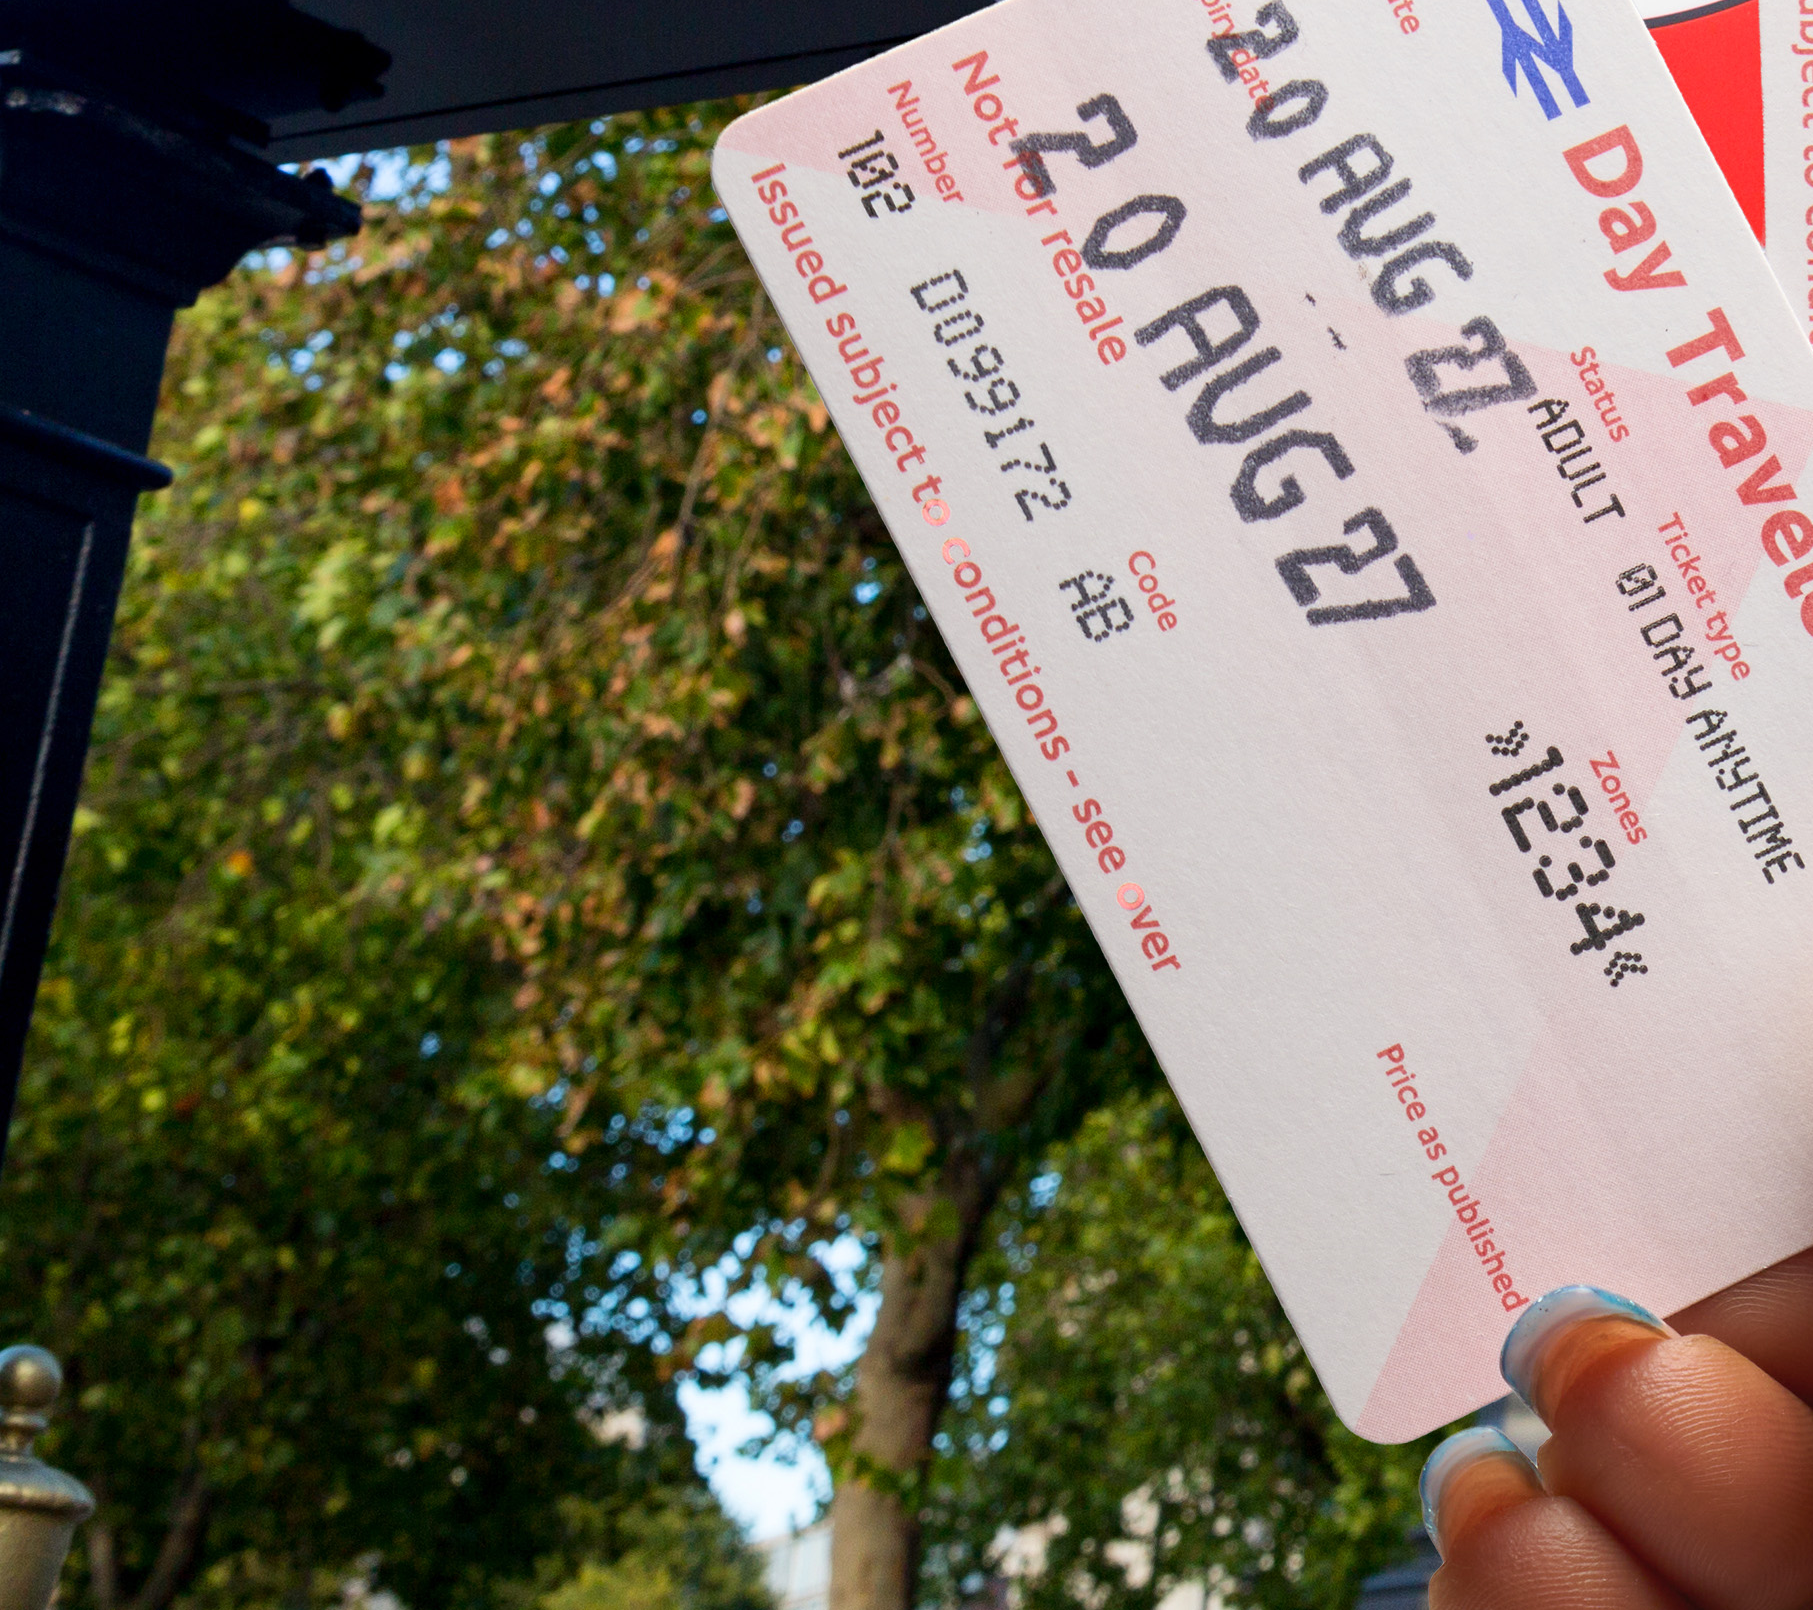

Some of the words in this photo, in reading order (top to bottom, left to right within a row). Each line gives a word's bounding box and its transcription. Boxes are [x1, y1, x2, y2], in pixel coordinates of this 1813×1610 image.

[1230, 47, 1278, 112] date
[888, 81, 966, 203] Number
[952, 51, 1020, 148] Not
[1001, 148, 1058, 218] for
[1042, 230, 1128, 367] resale
[1563, 124, 1689, 294] Day
[839, 131, 916, 219] 102
[911, 270, 1073, 523] D099172
[1299, 134, 1472, 315] AUG
[1405, 317, 1535, 425] 27
[1135, 286, 1356, 523] AUG
[1276, 508, 1438, 627] 27
[1571, 347, 1631, 444] Status
[1528, 400, 1627, 525] ADULT
[752, 163, 849, 306] Issued
[826, 312, 928, 474] subject
[912, 475, 952, 528] to
[942, 538, 1072, 763] conditions
[1073, 799, 1127, 875] see
[1117, 883, 1182, 972] over
[1059, 572, 1135, 643] AB
[1129, 551, 1179, 633] Code
[1617, 566, 1668, 610] 01
[1659, 512, 1717, 610] Ticket
[1706, 611, 1751, 682] type
[1641, 615, 1714, 701] DAY
[1590, 750, 1649, 846] Zones
[1686, 710, 1806, 885] ANYTIME
[1377, 1044, 1428, 1123] Price
[1418, 1127, 1448, 1162] as
[1432, 1166, 1531, 1314] published
